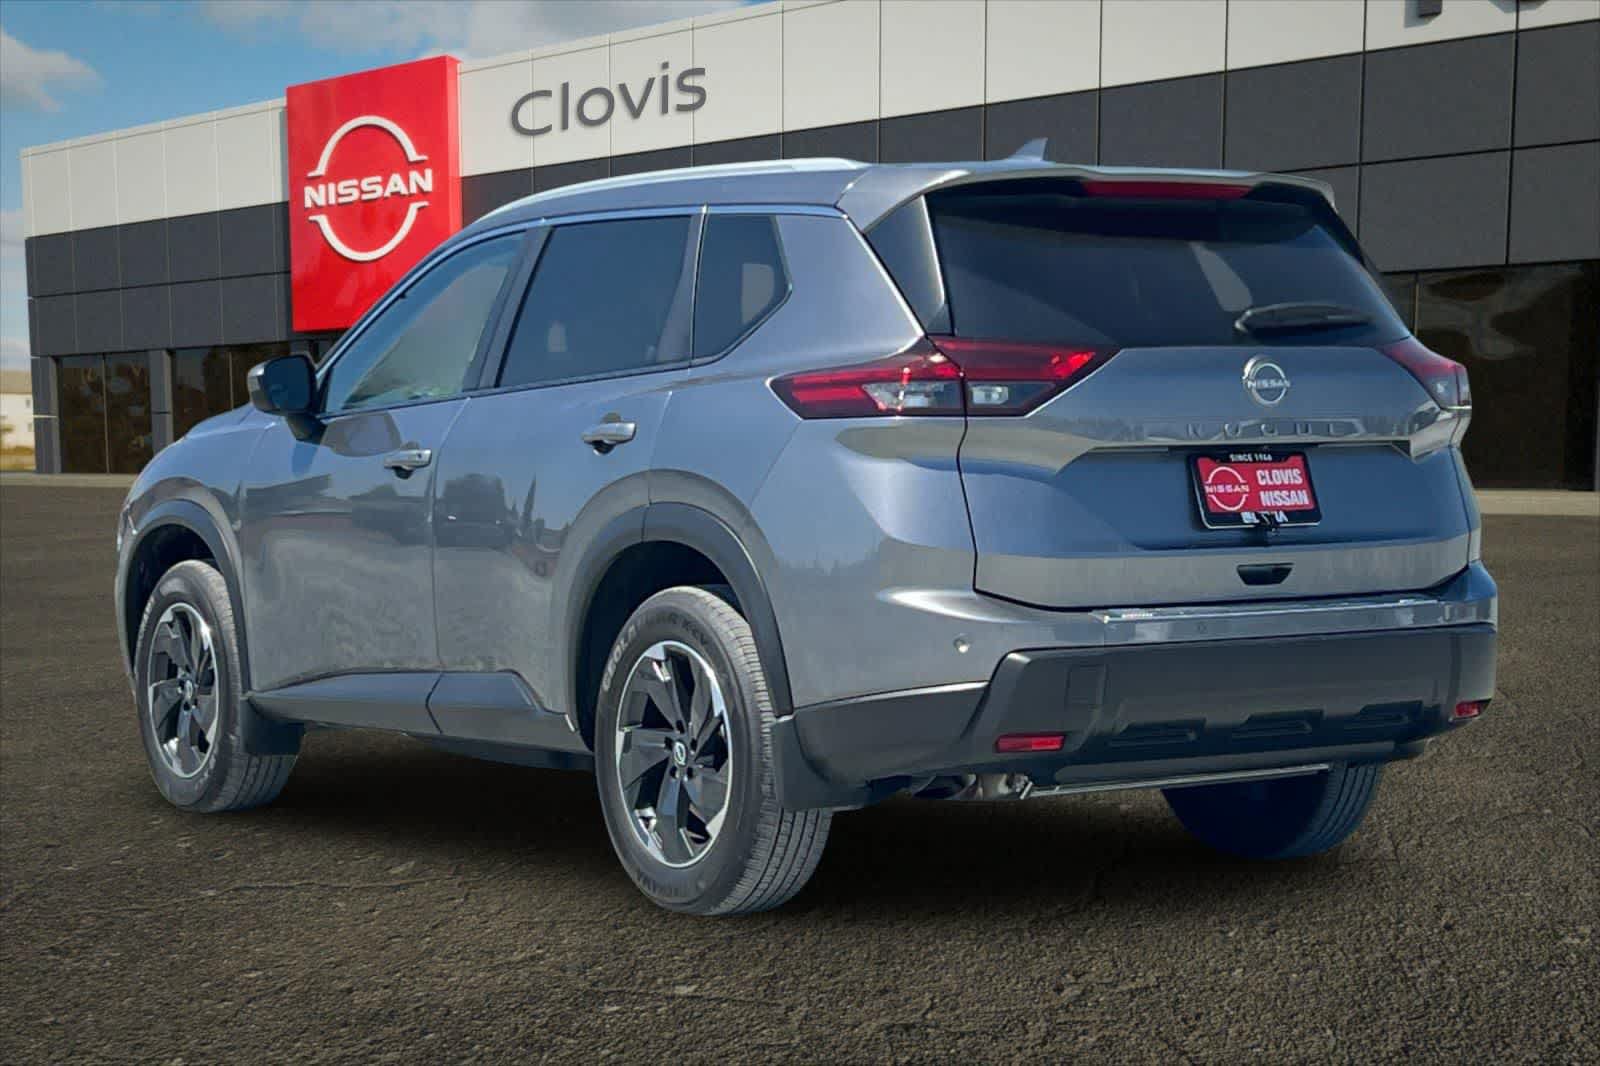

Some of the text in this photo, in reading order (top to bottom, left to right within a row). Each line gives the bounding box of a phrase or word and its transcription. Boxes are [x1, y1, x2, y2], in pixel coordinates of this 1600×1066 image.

[511, 62, 707, 136] Clovis
[304, 168, 433, 209] NISSAN
[1248, 379, 1290, 389] NISSAN
[1256, 468, 1303, 486] CLOVIS
[1205, 484, 1249, 493] NISSAN
[1259, 489, 1309, 507] NISSAN
